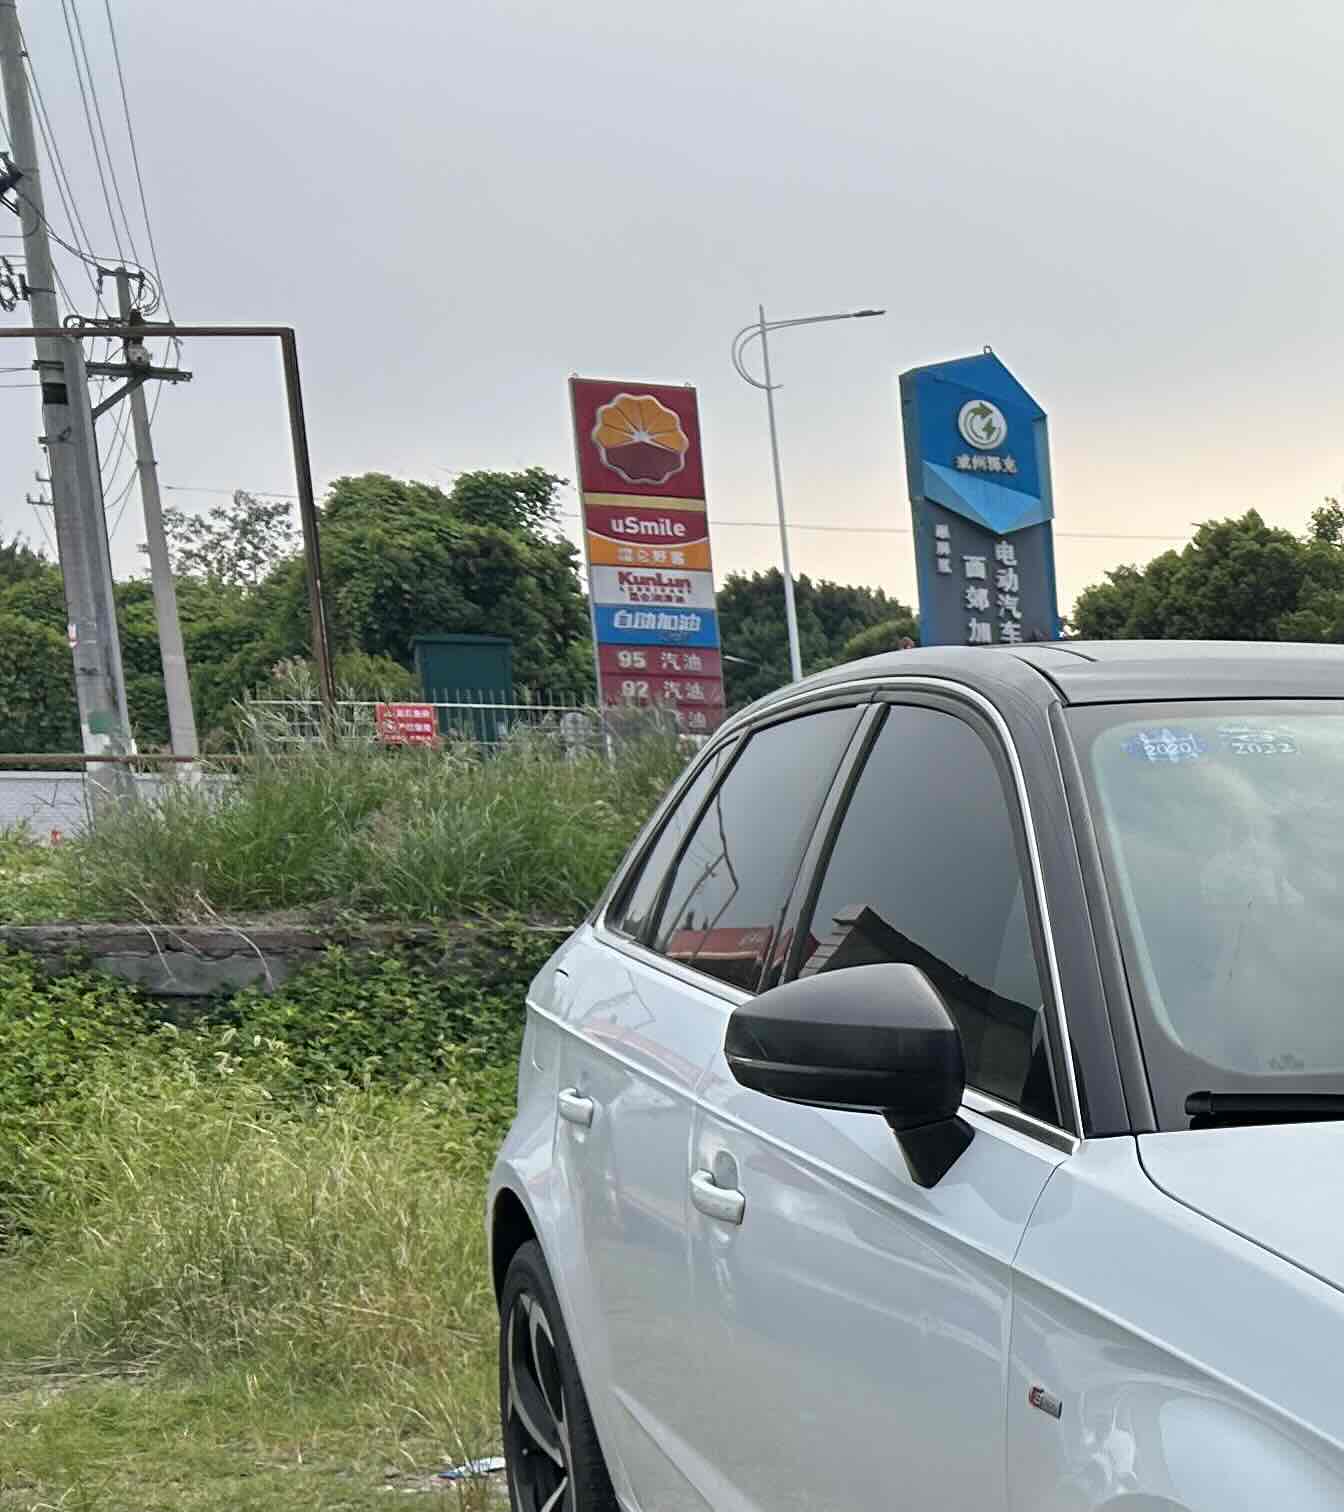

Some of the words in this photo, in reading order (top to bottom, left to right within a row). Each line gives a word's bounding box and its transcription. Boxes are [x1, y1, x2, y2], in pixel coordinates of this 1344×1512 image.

[610, 516, 687, 536] uSmile
[995, 540, 1022, 644] 电动汽车
[617, 650, 647, 669] 95
[661, 651, 702, 671] 汽油
[621, 680, 649, 698] 92
[663, 680, 704, 700] 汽油
